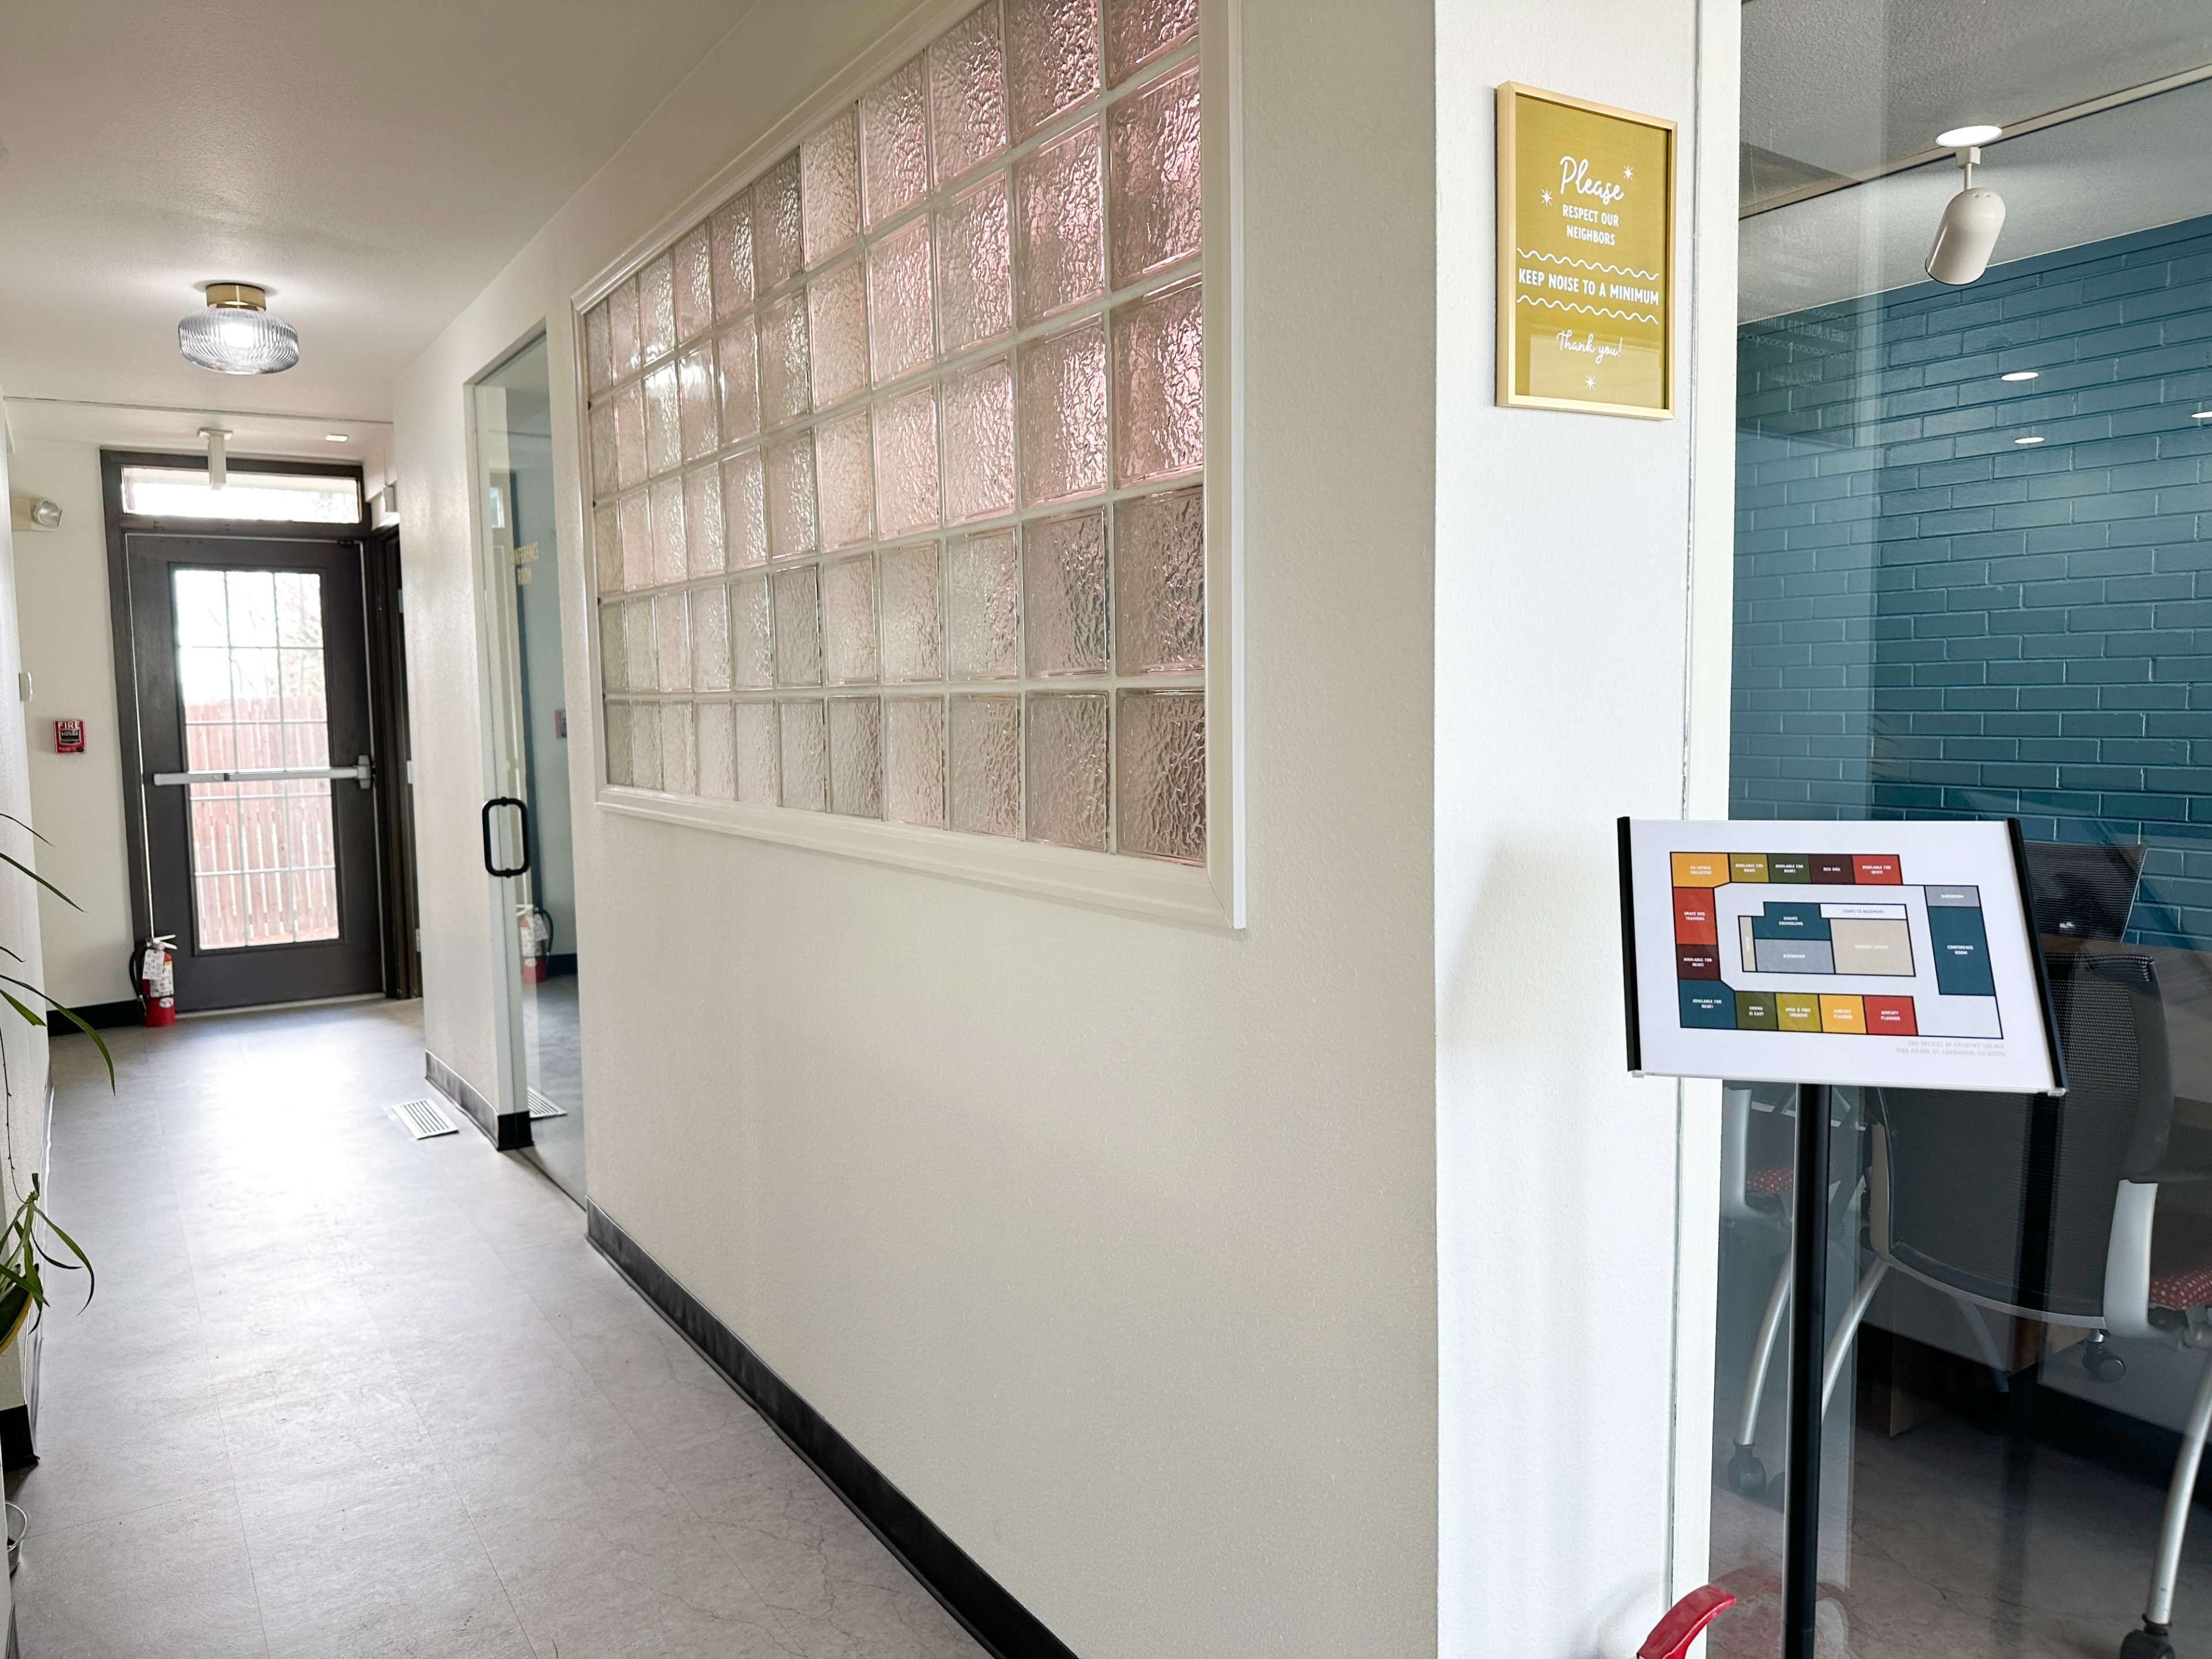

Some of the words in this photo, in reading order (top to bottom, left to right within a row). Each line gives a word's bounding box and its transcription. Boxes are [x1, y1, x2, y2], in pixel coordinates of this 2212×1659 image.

[1559, 156, 1625, 206] Please
[1562, 204, 1599, 224] RESPECT
[1601, 211, 1619, 227] OUR
[1566, 225, 1616, 247] NEIGHBORS
[1518, 267, 1544, 287] KEEP
[1548, 274, 1579, 293] NOISE
[1582, 279, 1596, 296] TO
[1599, 281, 1606, 297] A
[1610, 284, 1660, 306] MINIMUM
[1556, 330, 1596, 354] Thank
[1595, 337, 1623, 363] you!
[58, 720, 80, 729] FIRE
